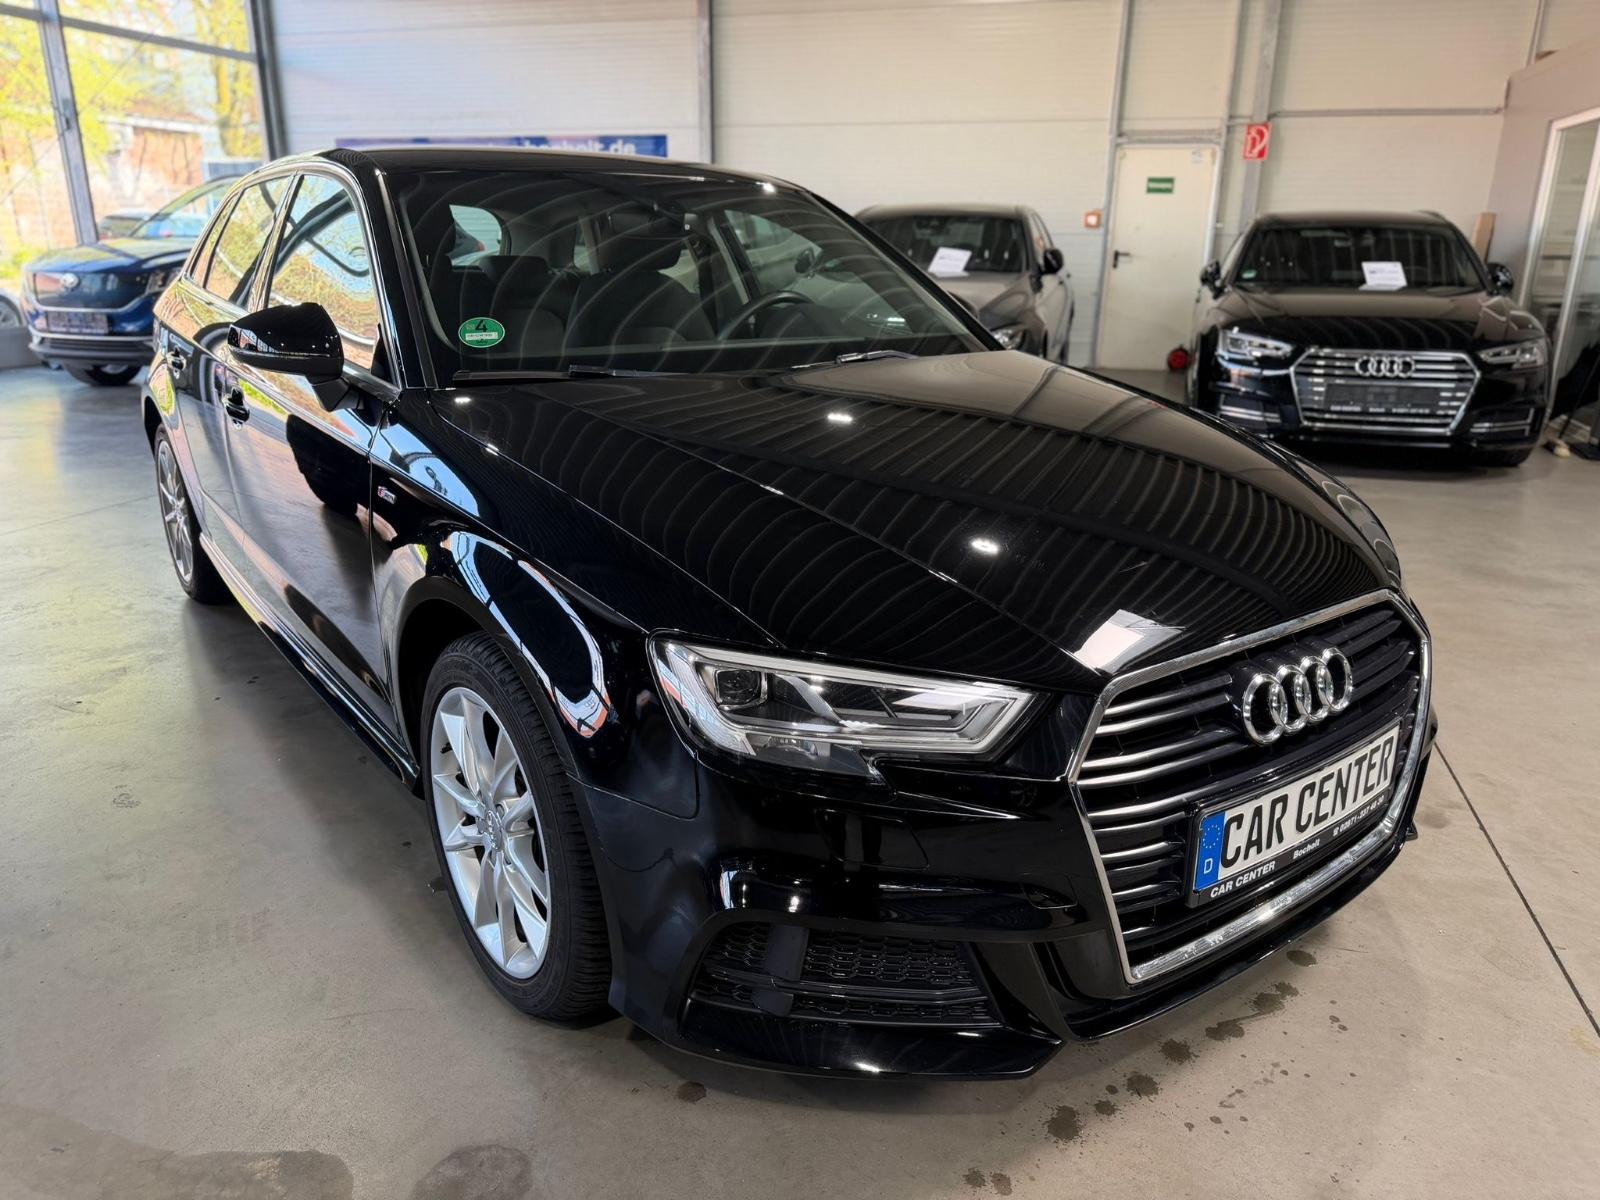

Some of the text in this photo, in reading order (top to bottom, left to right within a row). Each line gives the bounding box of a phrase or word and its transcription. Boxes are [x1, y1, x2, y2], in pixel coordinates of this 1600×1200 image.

[475, 319, 488, 333] 4
[1220, 736, 1395, 869] CAR CENTER
[1203, 857, 1214, 875] D
[1210, 880, 1234, 898] CAR
[1235, 861, 1276, 887] CENTER
